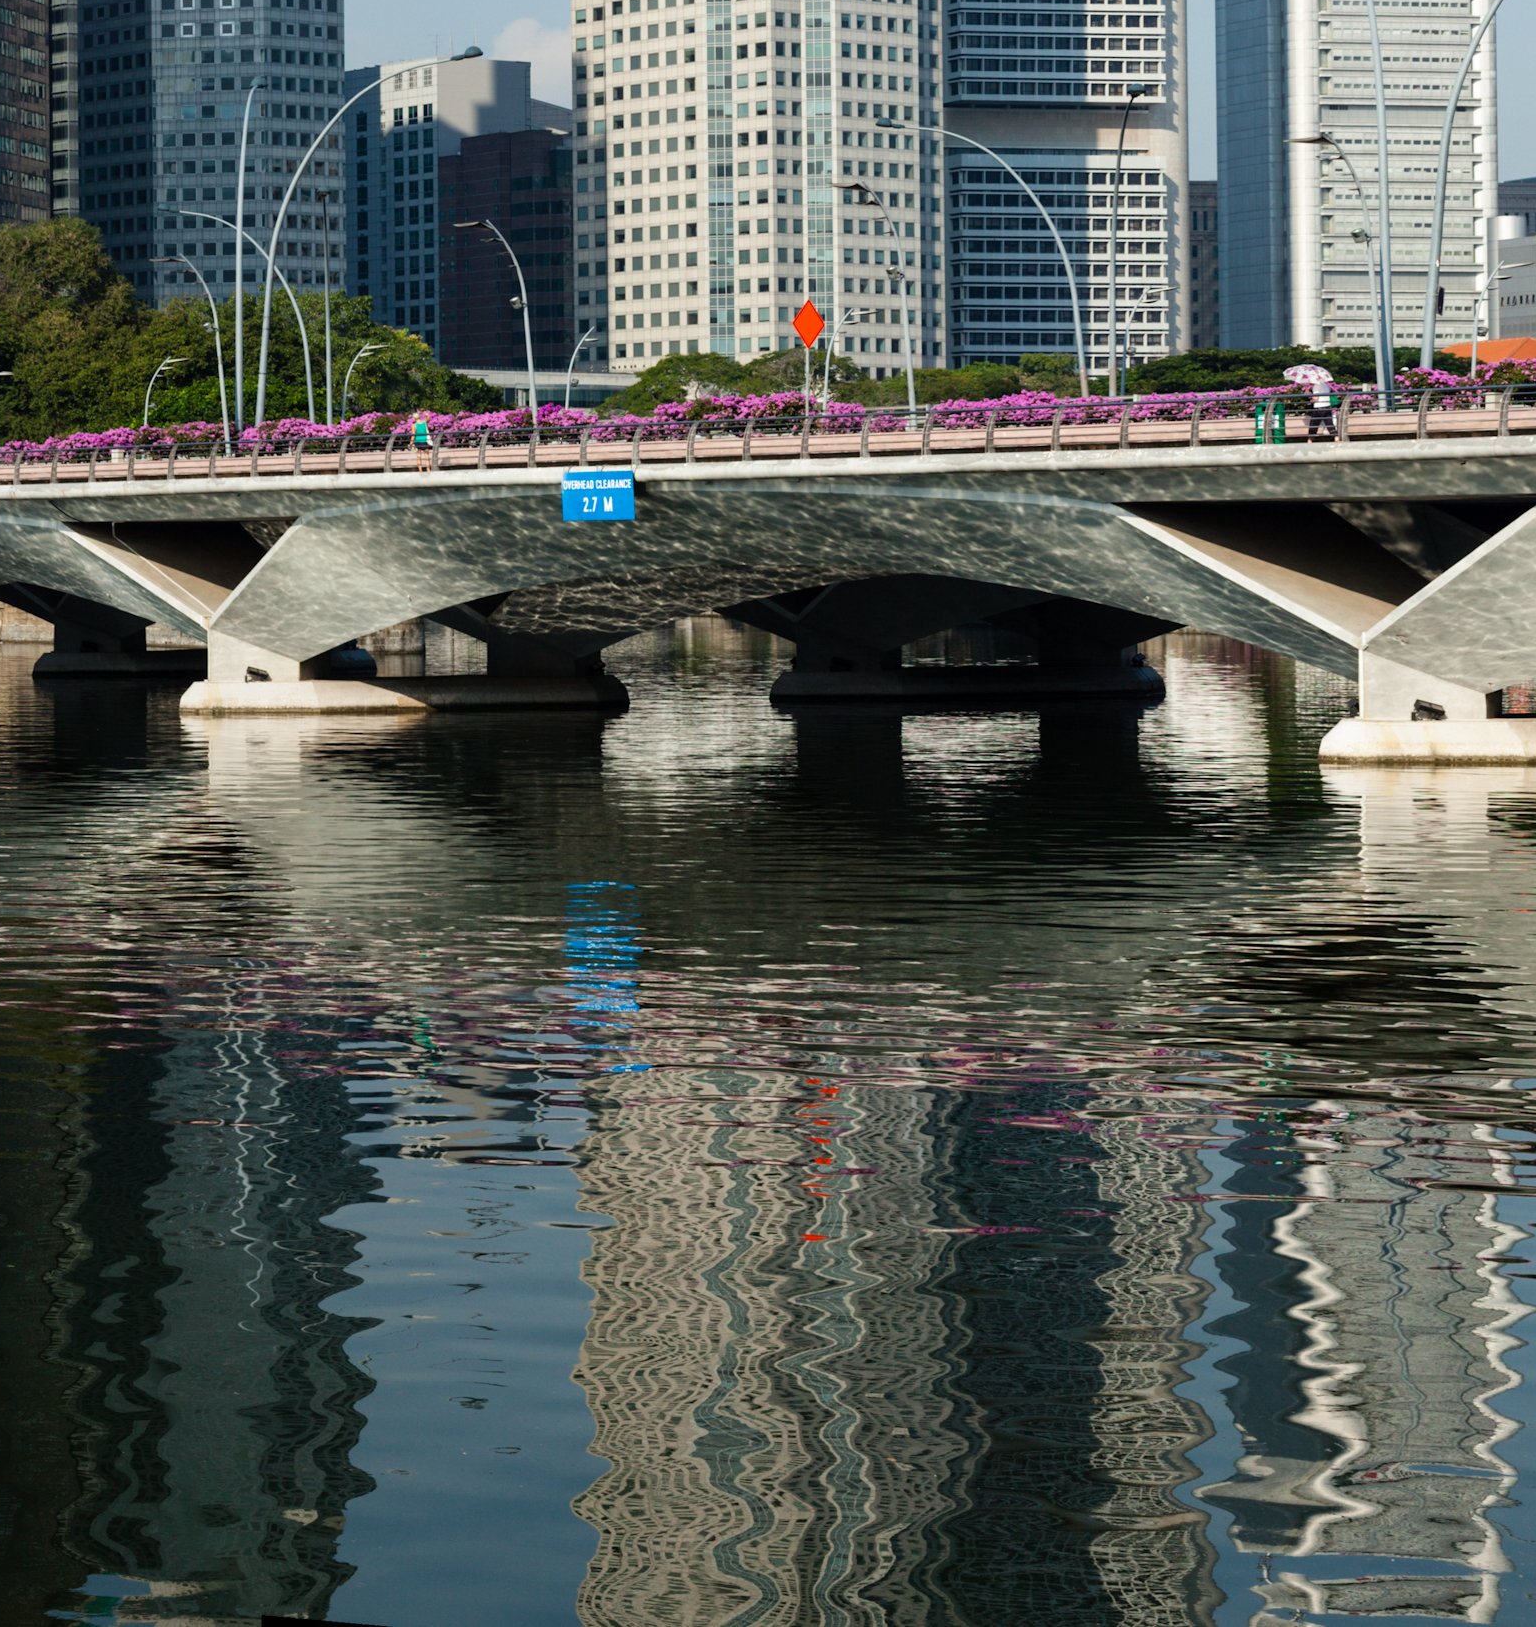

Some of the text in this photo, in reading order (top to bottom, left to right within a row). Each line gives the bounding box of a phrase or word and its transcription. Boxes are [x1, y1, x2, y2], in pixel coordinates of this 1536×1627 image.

[563, 478, 632, 490] OVERHEAD CLEARANCE
[583, 496, 613, 513] 2.7 M
